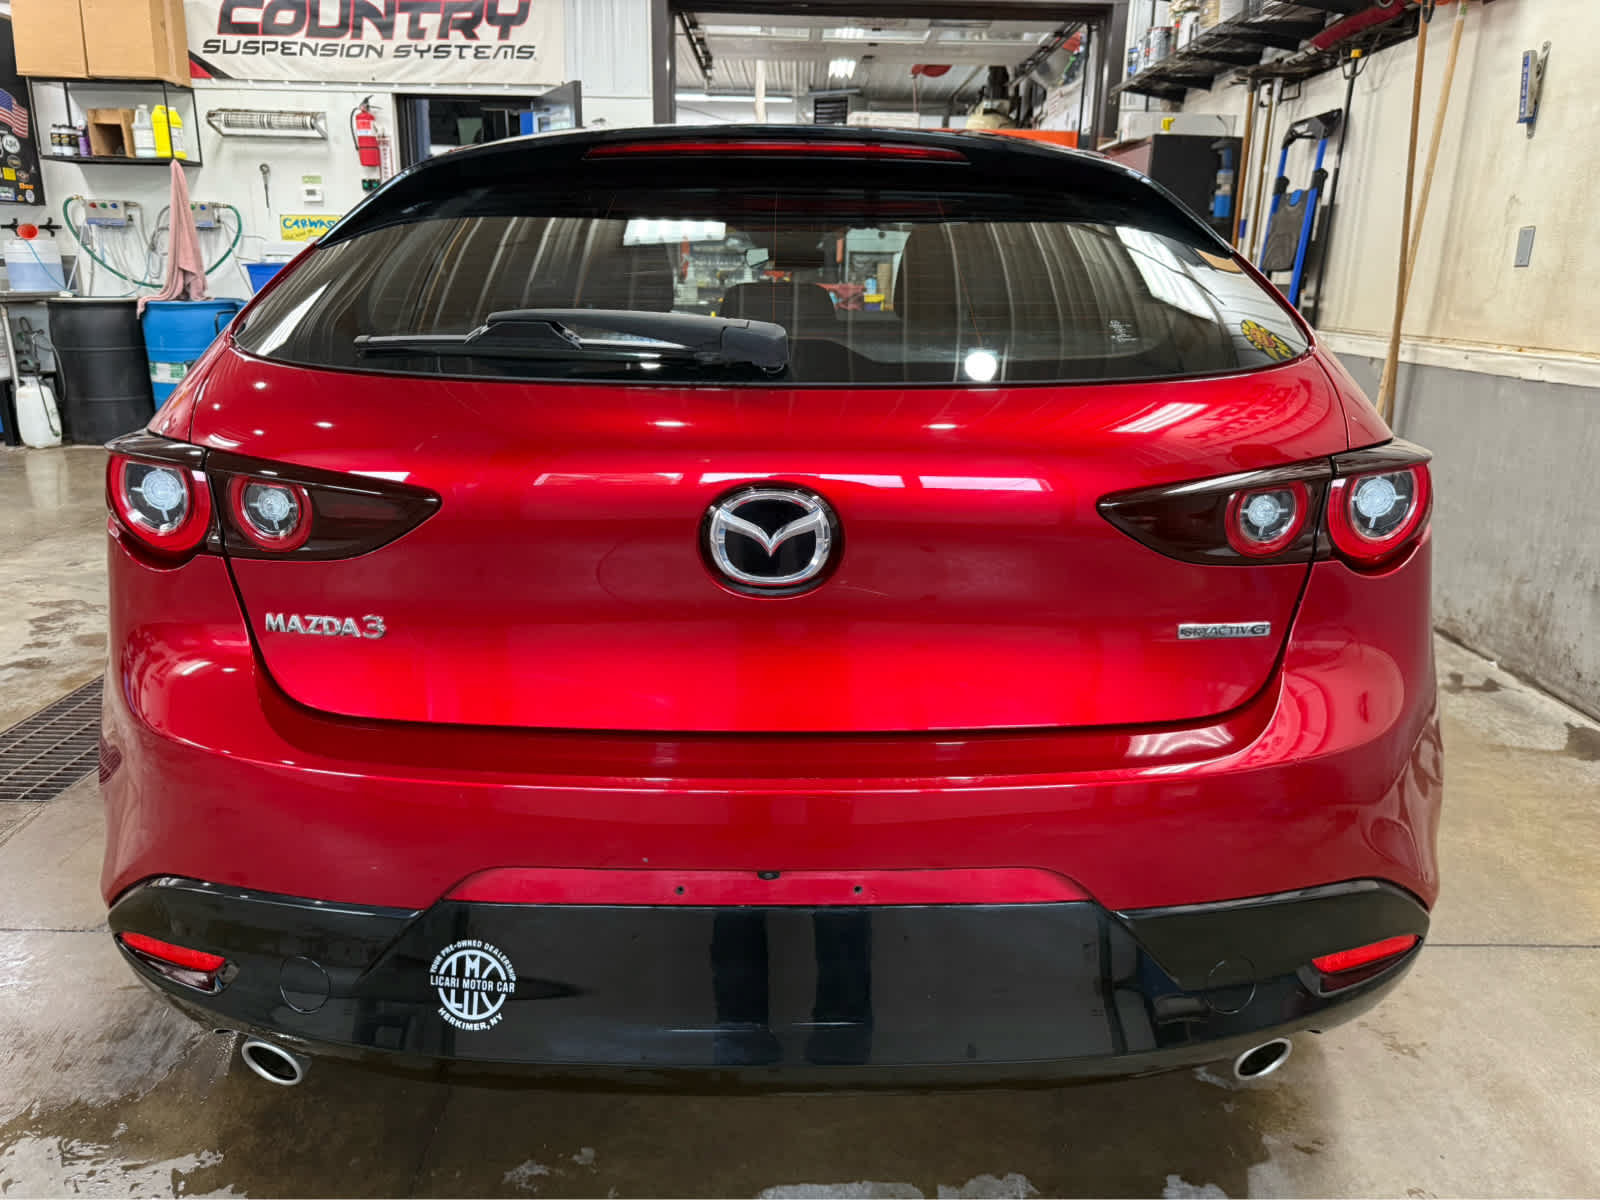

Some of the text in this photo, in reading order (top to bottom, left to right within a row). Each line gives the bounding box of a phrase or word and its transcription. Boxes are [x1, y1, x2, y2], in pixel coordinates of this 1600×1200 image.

[217, 0, 531, 40] COUNTRY
[203, 39, 536, 60] SUSPENSION SYSTEMS
[283, 218, 337, 229] CARWAS
[430, 955, 443, 974] YOUR
[484, 942, 517, 981] DEALERSHIP
[430, 975, 515, 993] LICARI MOTOR CAR
[490, 1012, 503, 1026] NY
